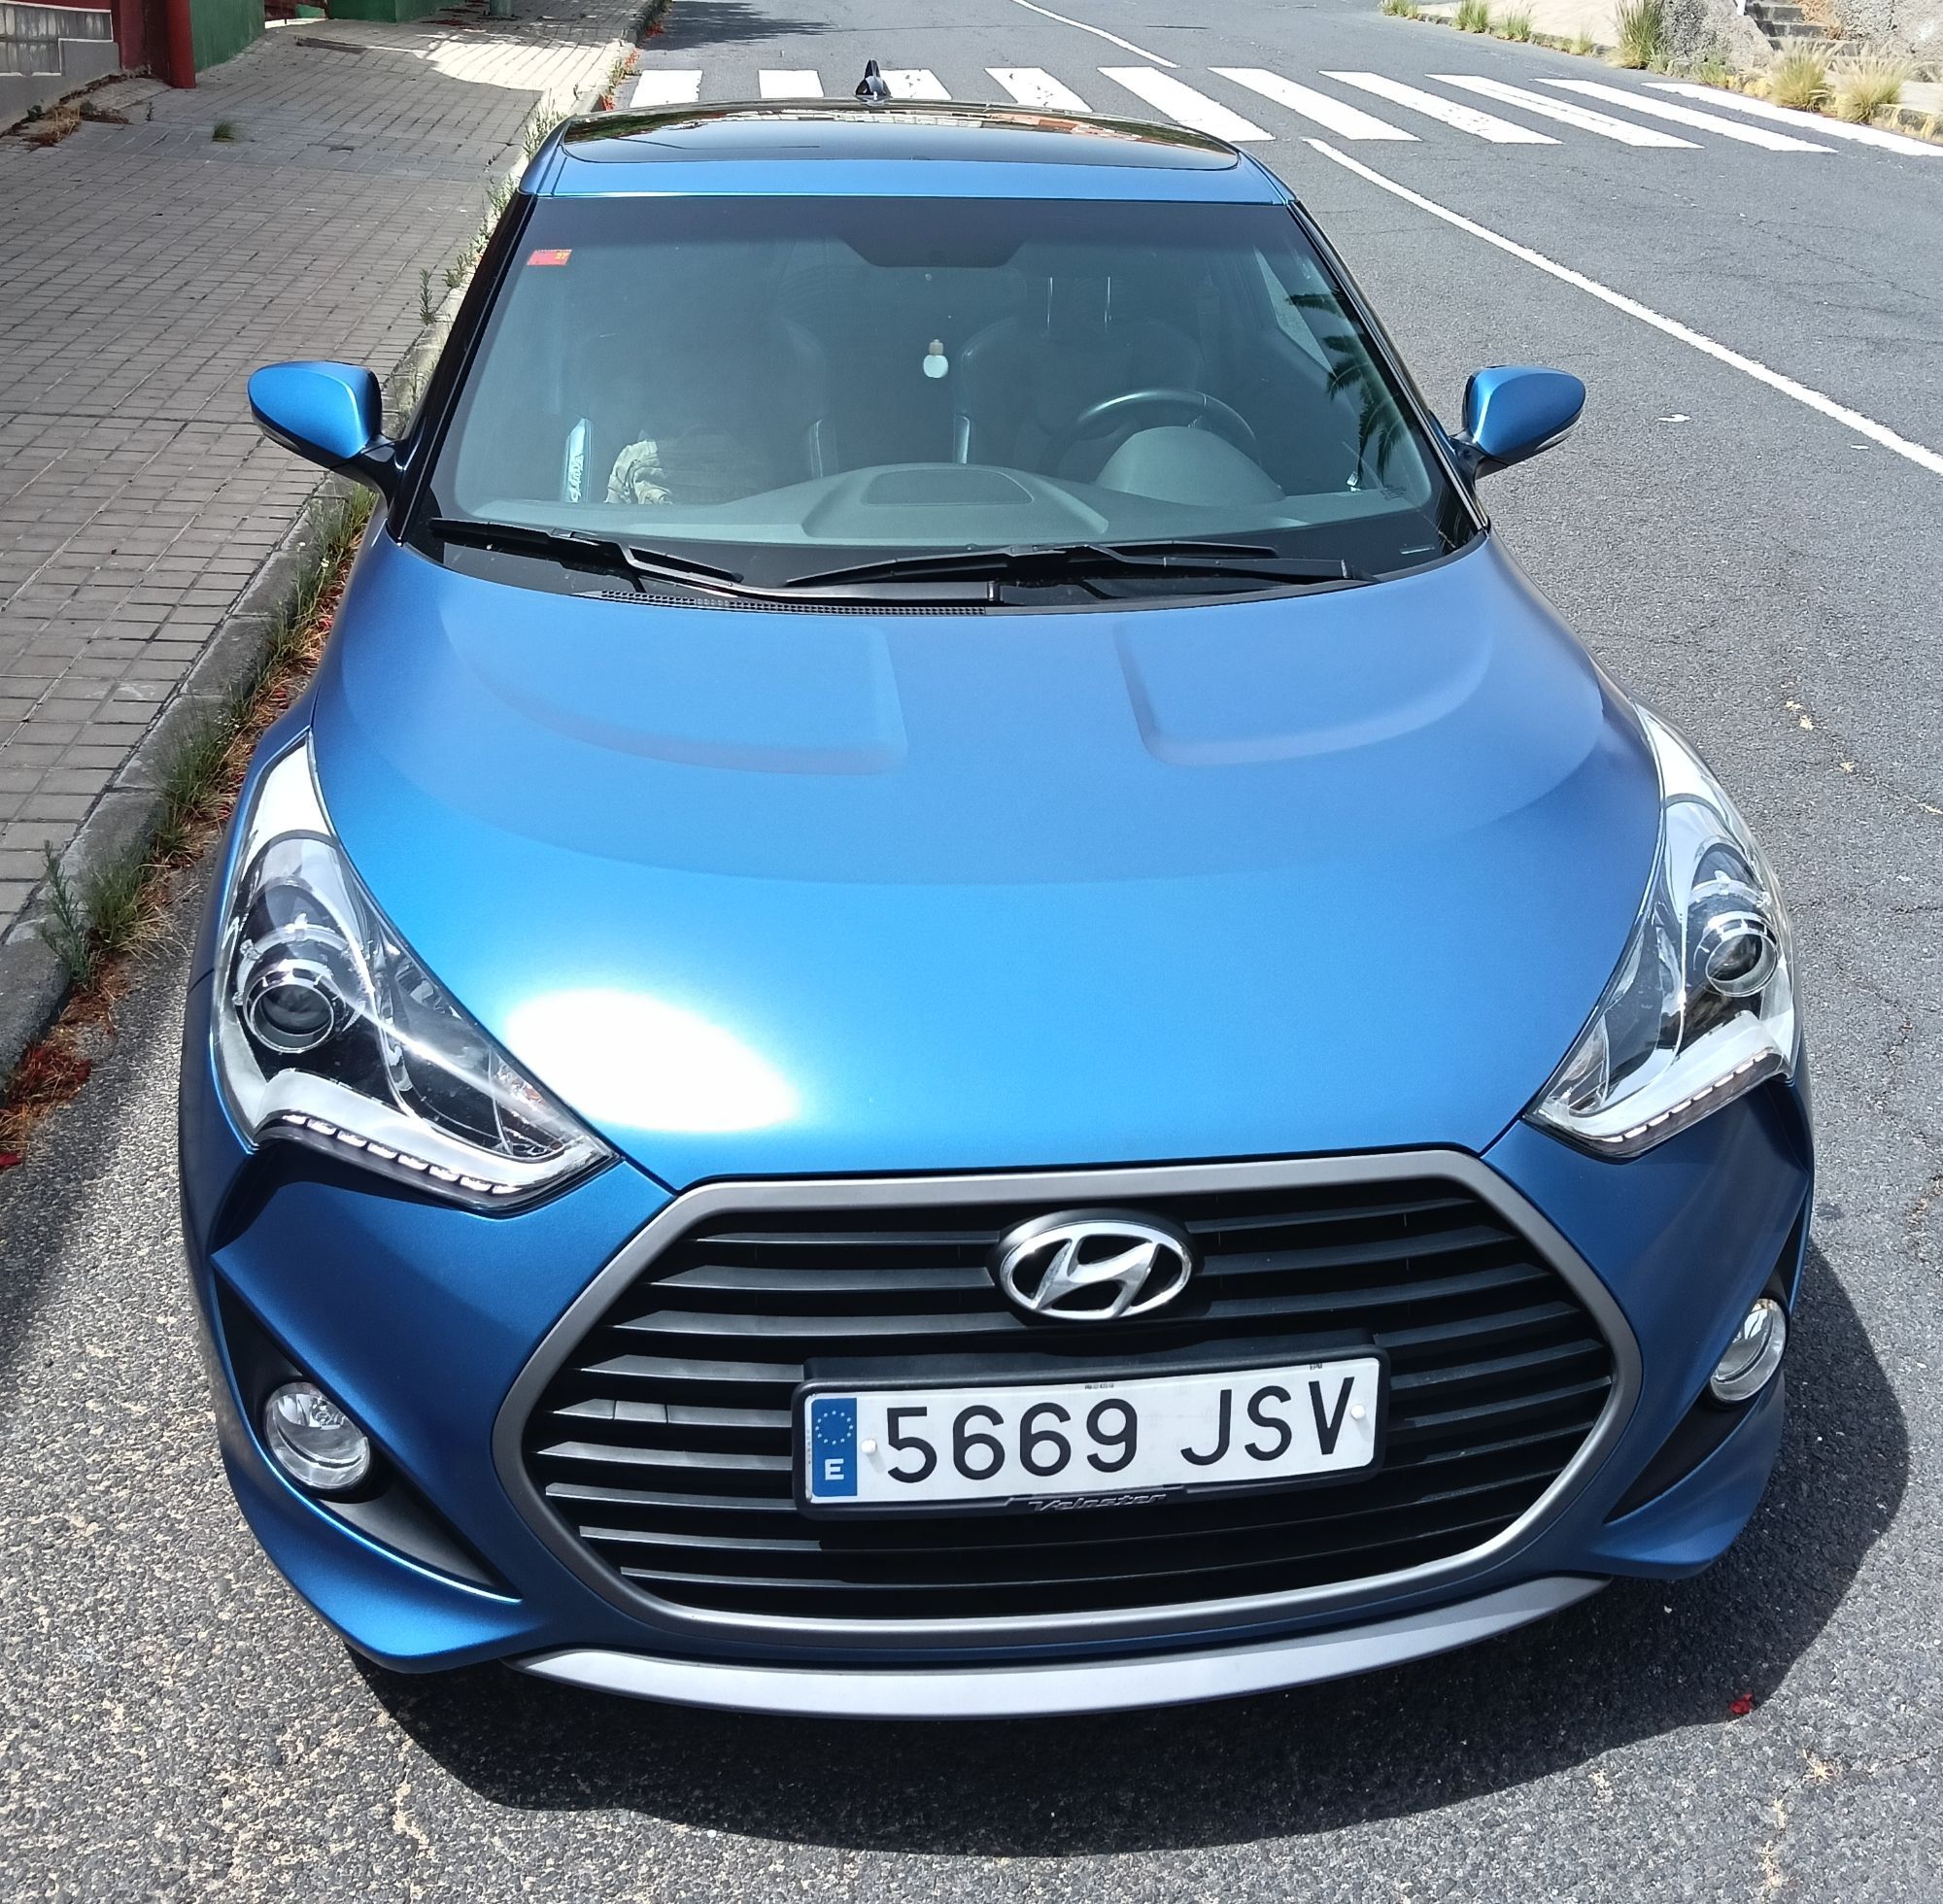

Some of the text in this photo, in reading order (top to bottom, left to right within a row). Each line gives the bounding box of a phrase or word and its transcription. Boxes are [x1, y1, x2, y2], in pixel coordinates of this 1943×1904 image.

[886, 1398, 1138, 1484] 5669
[1180, 1377, 1355, 1466] JSV
[824, 1458, 844, 1480] E
[1028, 1493, 1167, 1512] Veloster
